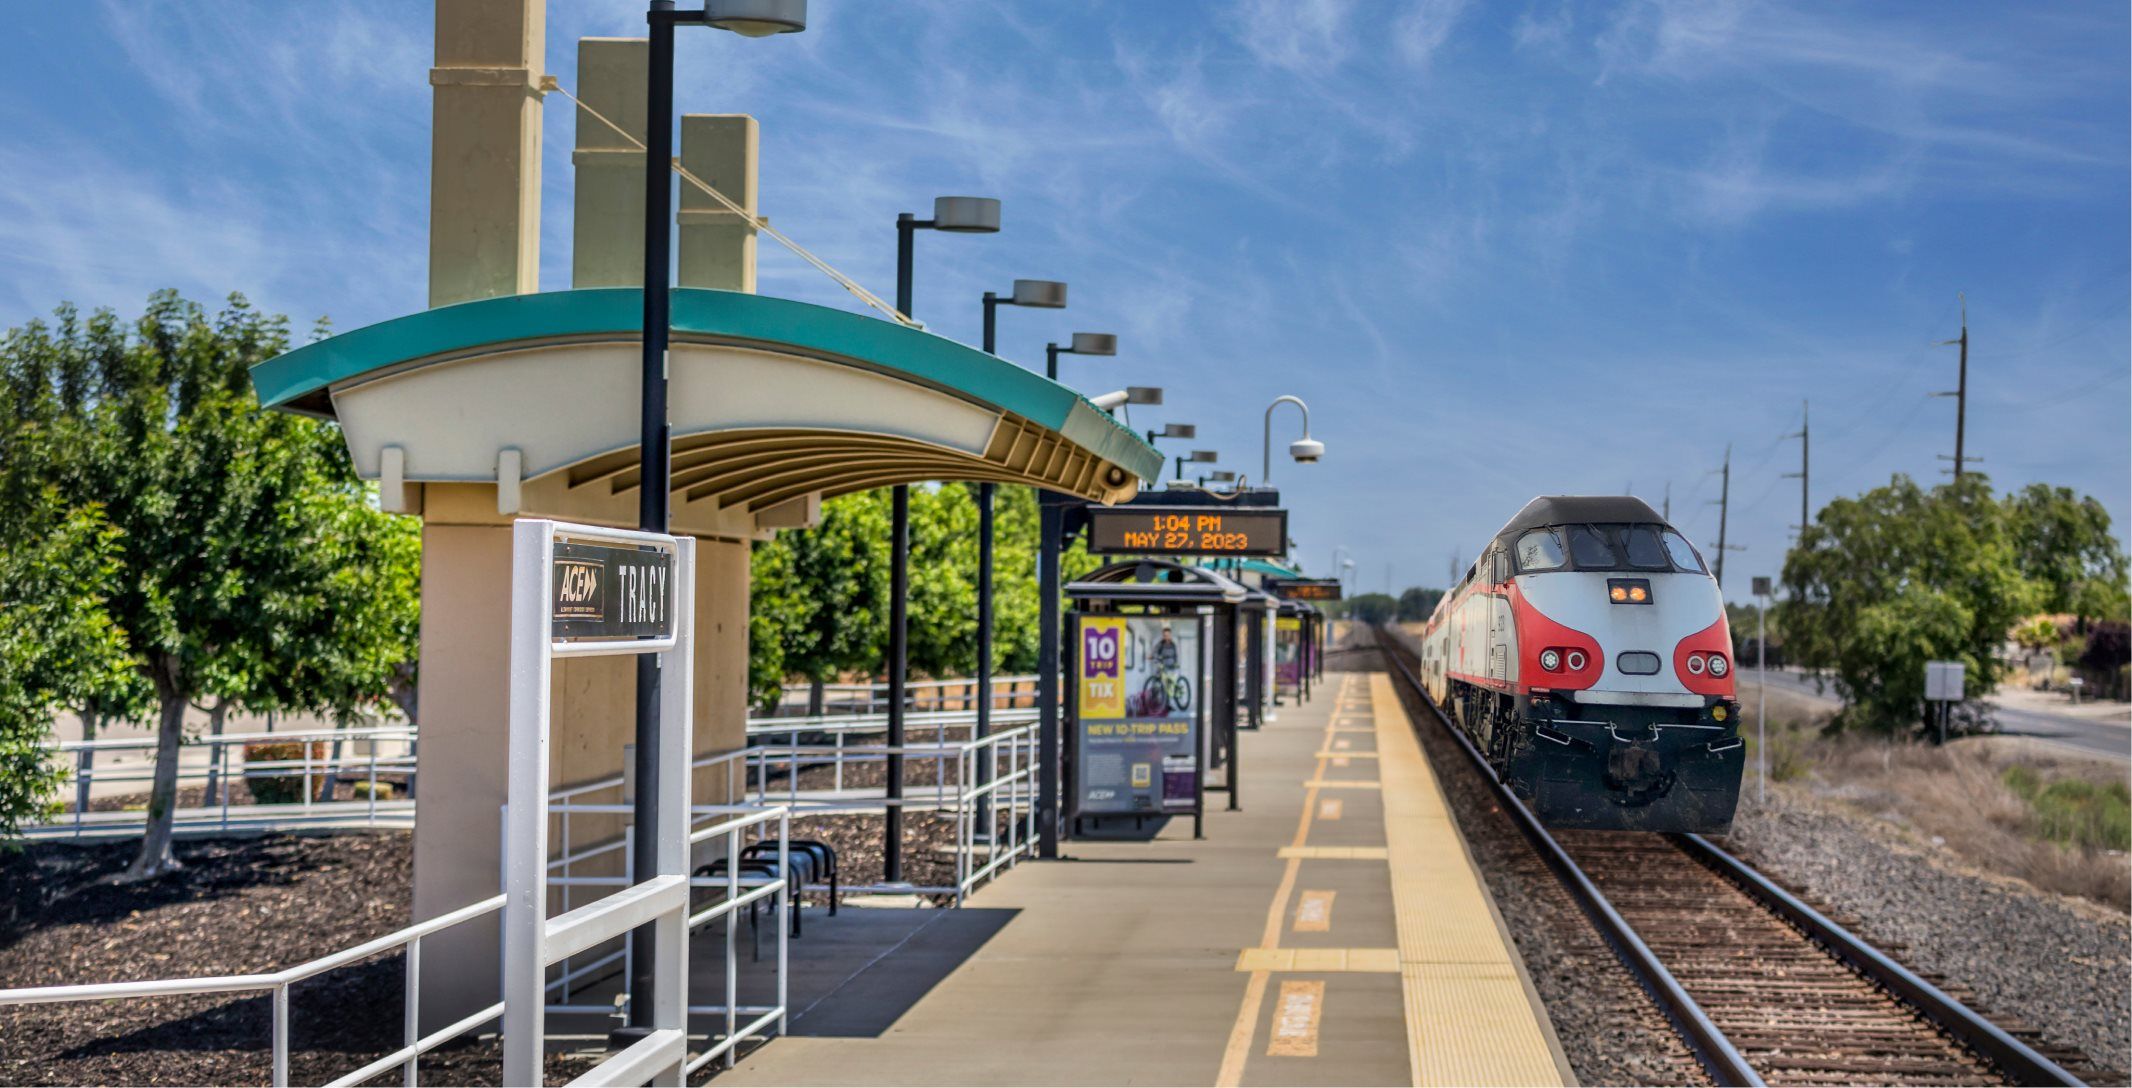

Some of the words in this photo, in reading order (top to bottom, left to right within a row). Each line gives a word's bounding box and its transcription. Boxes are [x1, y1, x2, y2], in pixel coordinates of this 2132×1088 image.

[1153, 515, 1190, 532] 1:04
[1197, 515, 1221, 532] PM
[1124, 532, 1160, 548] MAY
[1164, 533, 1194, 549] 27,
[1201, 533, 1248, 549] 2023
[560, 565, 585, 602] ACE
[619, 565, 666, 623] TRACY
[1088, 637, 1115, 660] 10
[1090, 661, 1113, 669] TRIP
[1089, 683, 1113, 698] TIX
[1088, 724, 1113, 735] NEW
[1116, 723, 1156, 735] 10-TRIP
[1159, 722, 1189, 734] PASS
